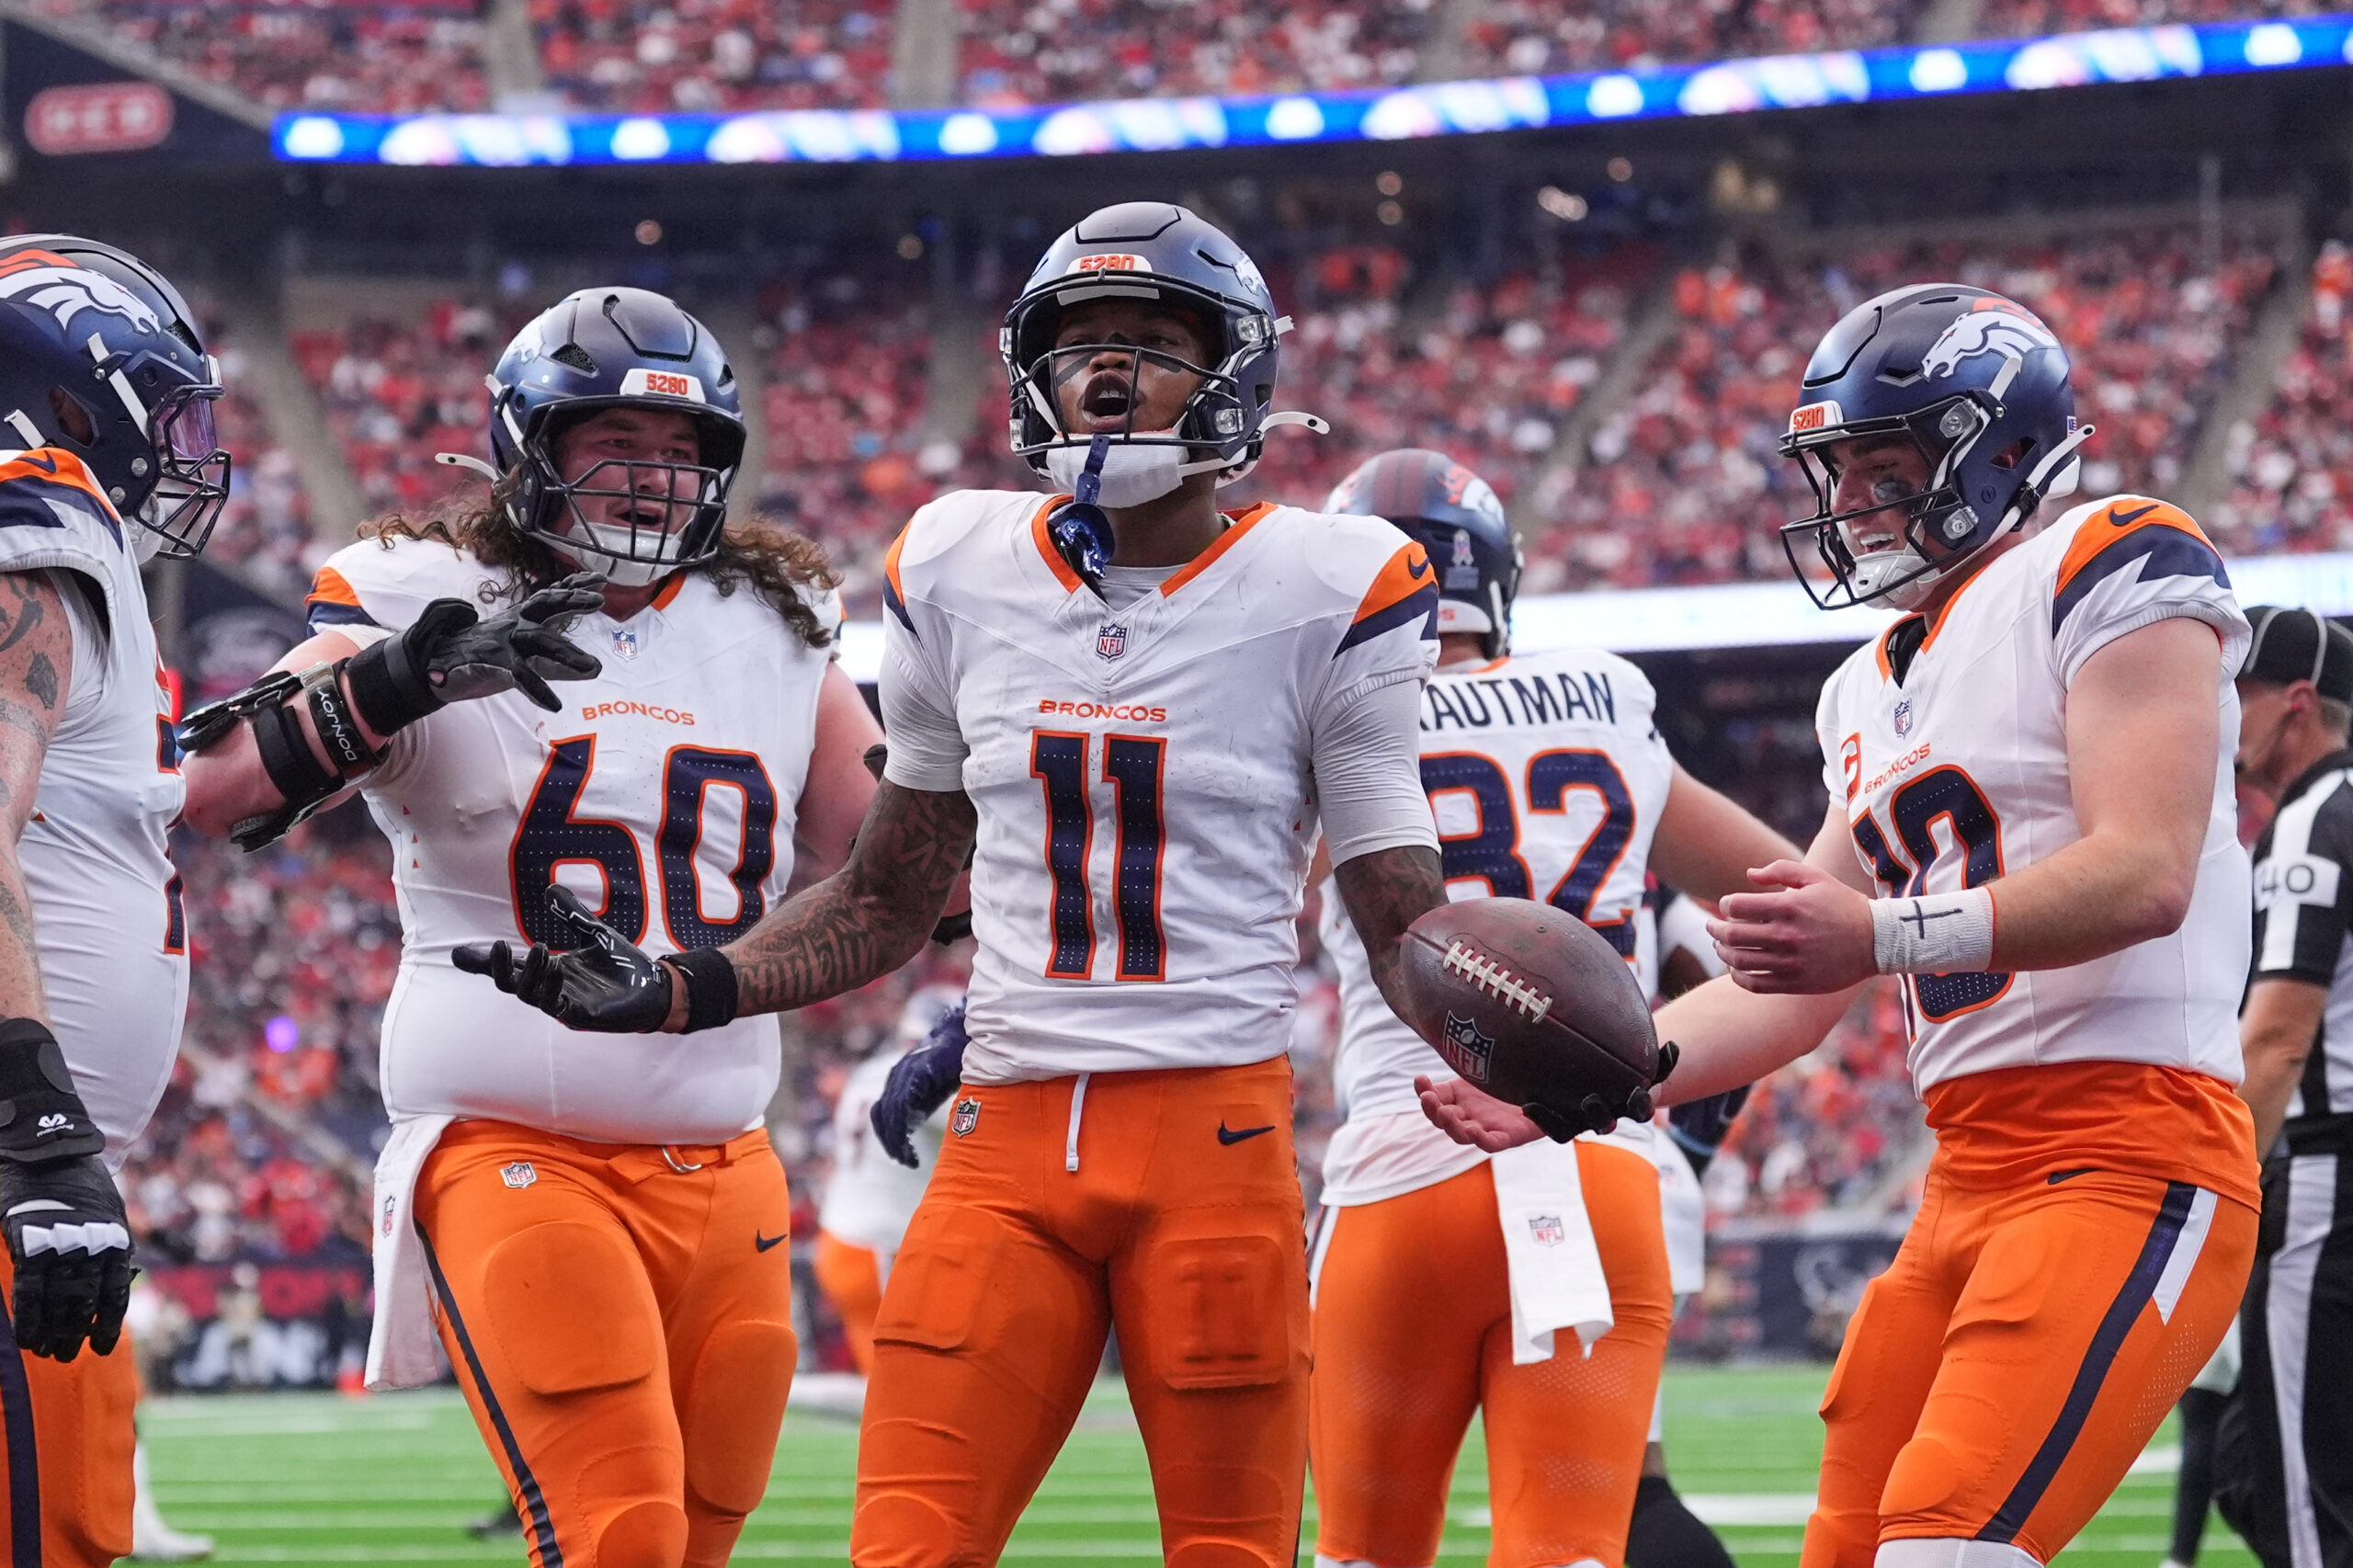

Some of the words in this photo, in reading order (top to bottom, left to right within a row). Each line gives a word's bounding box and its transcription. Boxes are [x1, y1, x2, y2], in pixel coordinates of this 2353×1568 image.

[645, 373, 688, 396] 5280
[1792, 406, 1824, 431] 5280
[1099, 638, 1122, 654] NFL
[582, 700, 696, 726] BRONCOS
[1039, 699, 1167, 722] BRONCOS
[1420, 670, 1617, 732] AUTMAN
[316, 687, 358, 762] DONJOY
[1864, 743, 1932, 795] BRONCOS
[508, 733, 779, 955] 60
[1029, 729, 1168, 982] 11
[1446, 1036, 1486, 1079] NFL
[508, 1170, 532, 1184] NFL
[1535, 1228, 1563, 1244] NFL
